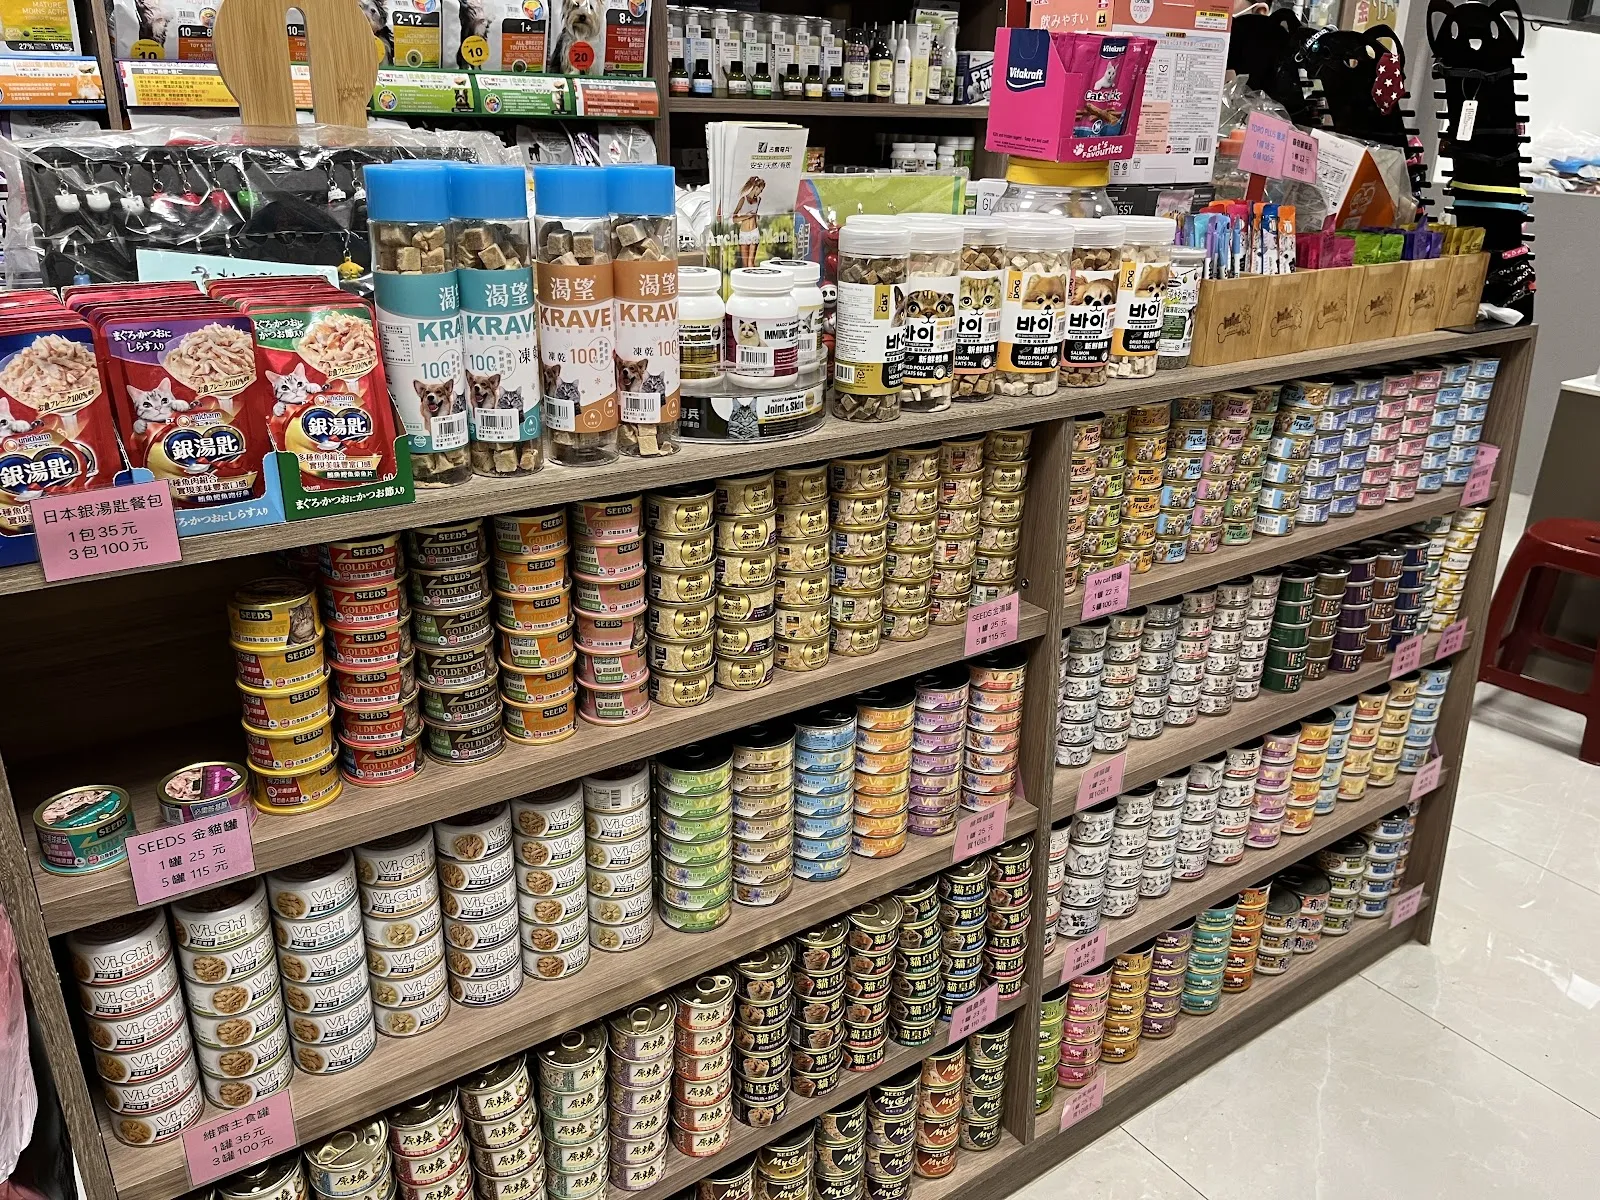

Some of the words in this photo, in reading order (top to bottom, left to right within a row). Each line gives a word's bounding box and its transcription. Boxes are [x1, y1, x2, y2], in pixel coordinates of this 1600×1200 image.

[396, 13, 422, 25] 2-12
[619, 13, 632, 24] 8+
[1040, 13, 1089, 28] 飲みやすい
[520, 22, 531, 33] 1+
[468, 47, 483, 58] 10
[574, 53, 588, 62] 20
[1009, 67, 1043, 80] Vitakraft
[1082, 145, 1123, 159] Favourites
[1088, 141, 1109, 152] Cat's
[550, 277, 595, 302] 渴望
[638, 273, 676, 296] 渴望
[485, 283, 529, 308] 渴望
[540, 305, 611, 329] KRAVE
[620, 304, 679, 323] KRAV
[1070, 312, 1105, 329] 바이
[417, 318, 461, 342] KRA
[1017, 316, 1053, 333] 바이
[765, 404, 784, 415] Joint
[790, 400, 804, 411] Skin
[190, 411, 221, 421] unicharm
[308, 417, 367, 436] 銀湯匙
[18, 432, 52, 444] unicharm
[171, 435, 239, 461] 銀湯匙
[1, 457, 73, 488] 銀湯匙
[170, 475, 218, 487] 種魚肉組合
[43, 494, 162, 524] 日本銀湯匙餐包
[606, 504, 632, 515] SEEDS
[543, 517, 563, 529] SEEDS
[439, 530, 467, 541] SEEDS
[353, 545, 384, 557] SEEDS
[529, 558, 556, 570] SEEDS
[442, 571, 471, 582] SEEDS
[356, 588, 386, 600] SEEDS
[355, 632, 386, 641] SEEDS
[287, 645, 315, 661] SEEDS
[446, 651, 474, 662] SEEDS
[355, 672, 386, 682] SEEDS
[291, 686, 319, 702] SEEDS
[359, 711, 389, 720] SEEDS
[99, 816, 127, 836] SEEDS
[138, 832, 186, 855] SEEDS
[192, 818, 239, 841] 金貓罐
[379, 849, 426, 874] Vi.Chi
[373, 885, 422, 905] Vi.Chi
[463, 886, 507, 909] Vi.Chi
[190, 914, 247, 938] Vi.Chi
[292, 915, 344, 940] Vi.Chi
[312, 939, 358, 970] Vi.Chi
[316, 969, 362, 1001] Vi.Chi
[467, 973, 511, 996] Vi.Chi
[117, 1004, 171, 1037] Vi.Chi
[131, 1032, 182, 1066] Vi.Chi
[123, 1075, 179, 1102] Vi.Chi
